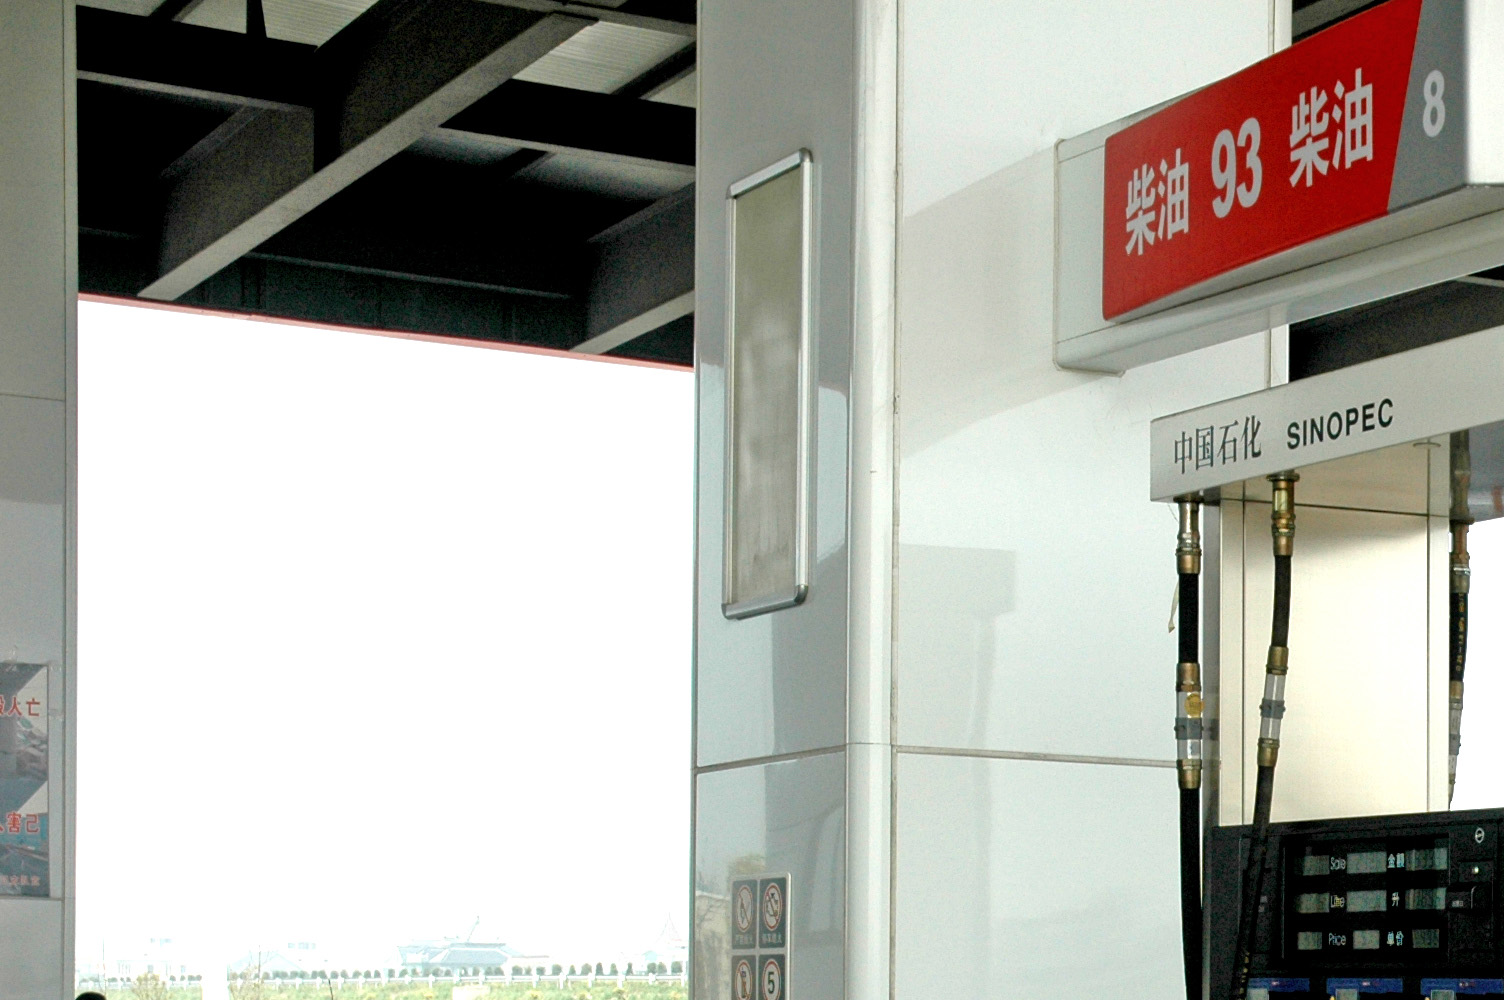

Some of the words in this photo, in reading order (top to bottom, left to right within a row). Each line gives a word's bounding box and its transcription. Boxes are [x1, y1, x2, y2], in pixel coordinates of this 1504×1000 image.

[1422, 69, 1447, 138] 8
[1124, 147, 1190, 257] 柴油
[1210, 116, 1263, 219] 93
[1288, 66, 1375, 189] 柴油
[1173, 414, 1263, 475] 中国石化
[1286, 397, 1395, 449] SINOPEC
[767, 971, 775, 994] 5
